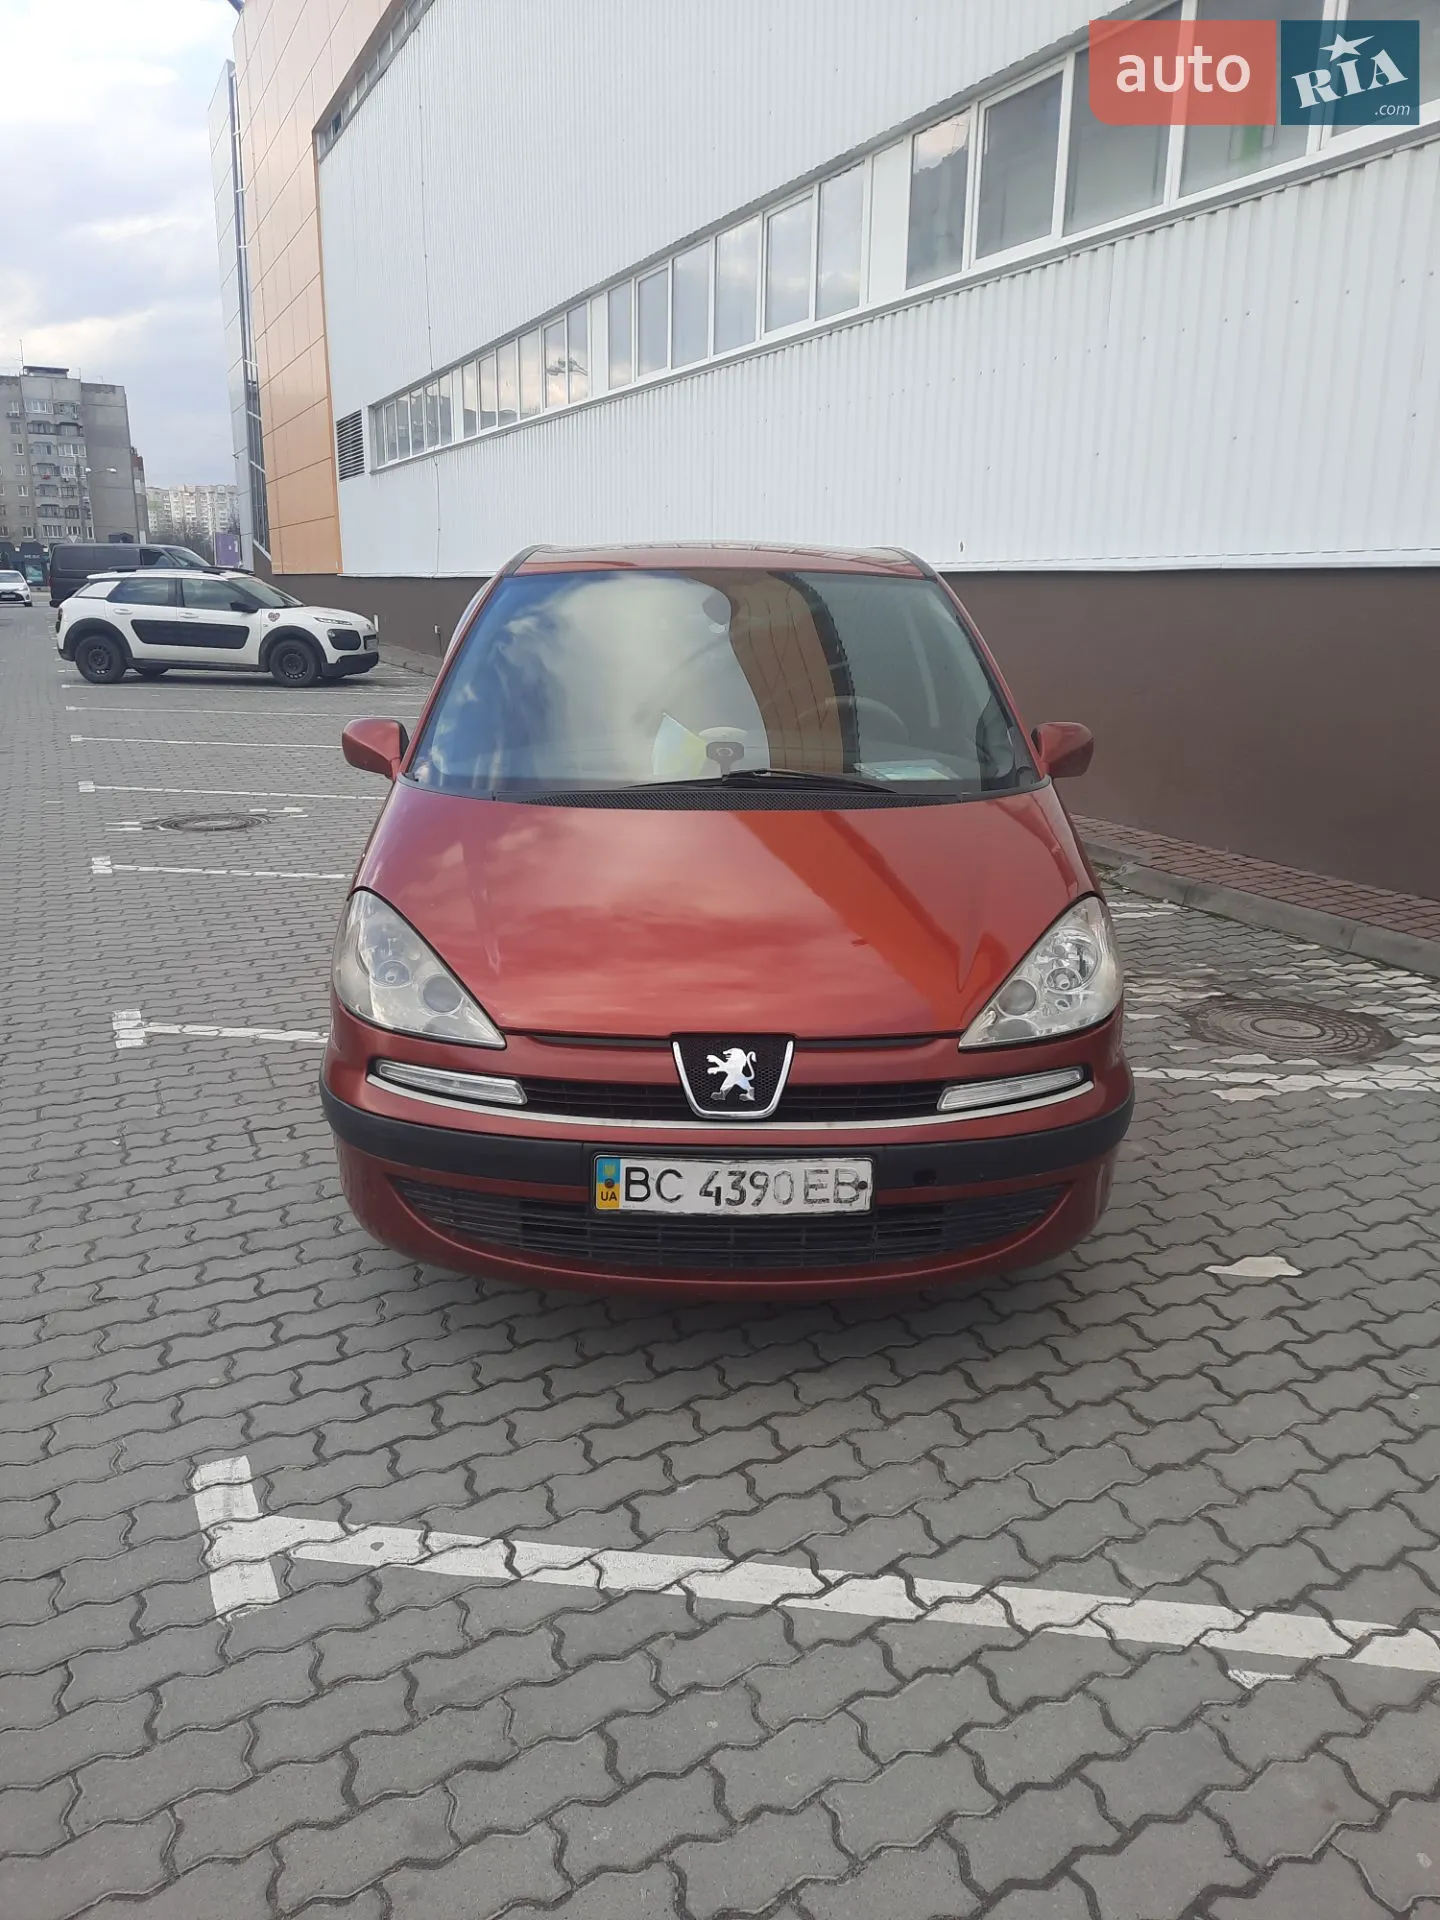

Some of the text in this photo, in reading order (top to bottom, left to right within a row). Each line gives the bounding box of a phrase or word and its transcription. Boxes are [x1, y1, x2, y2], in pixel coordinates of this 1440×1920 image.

[600, 1191, 618, 1202] UA
[624, 1166, 684, 1204] BC
[699, 1168, 795, 1207] 4390
